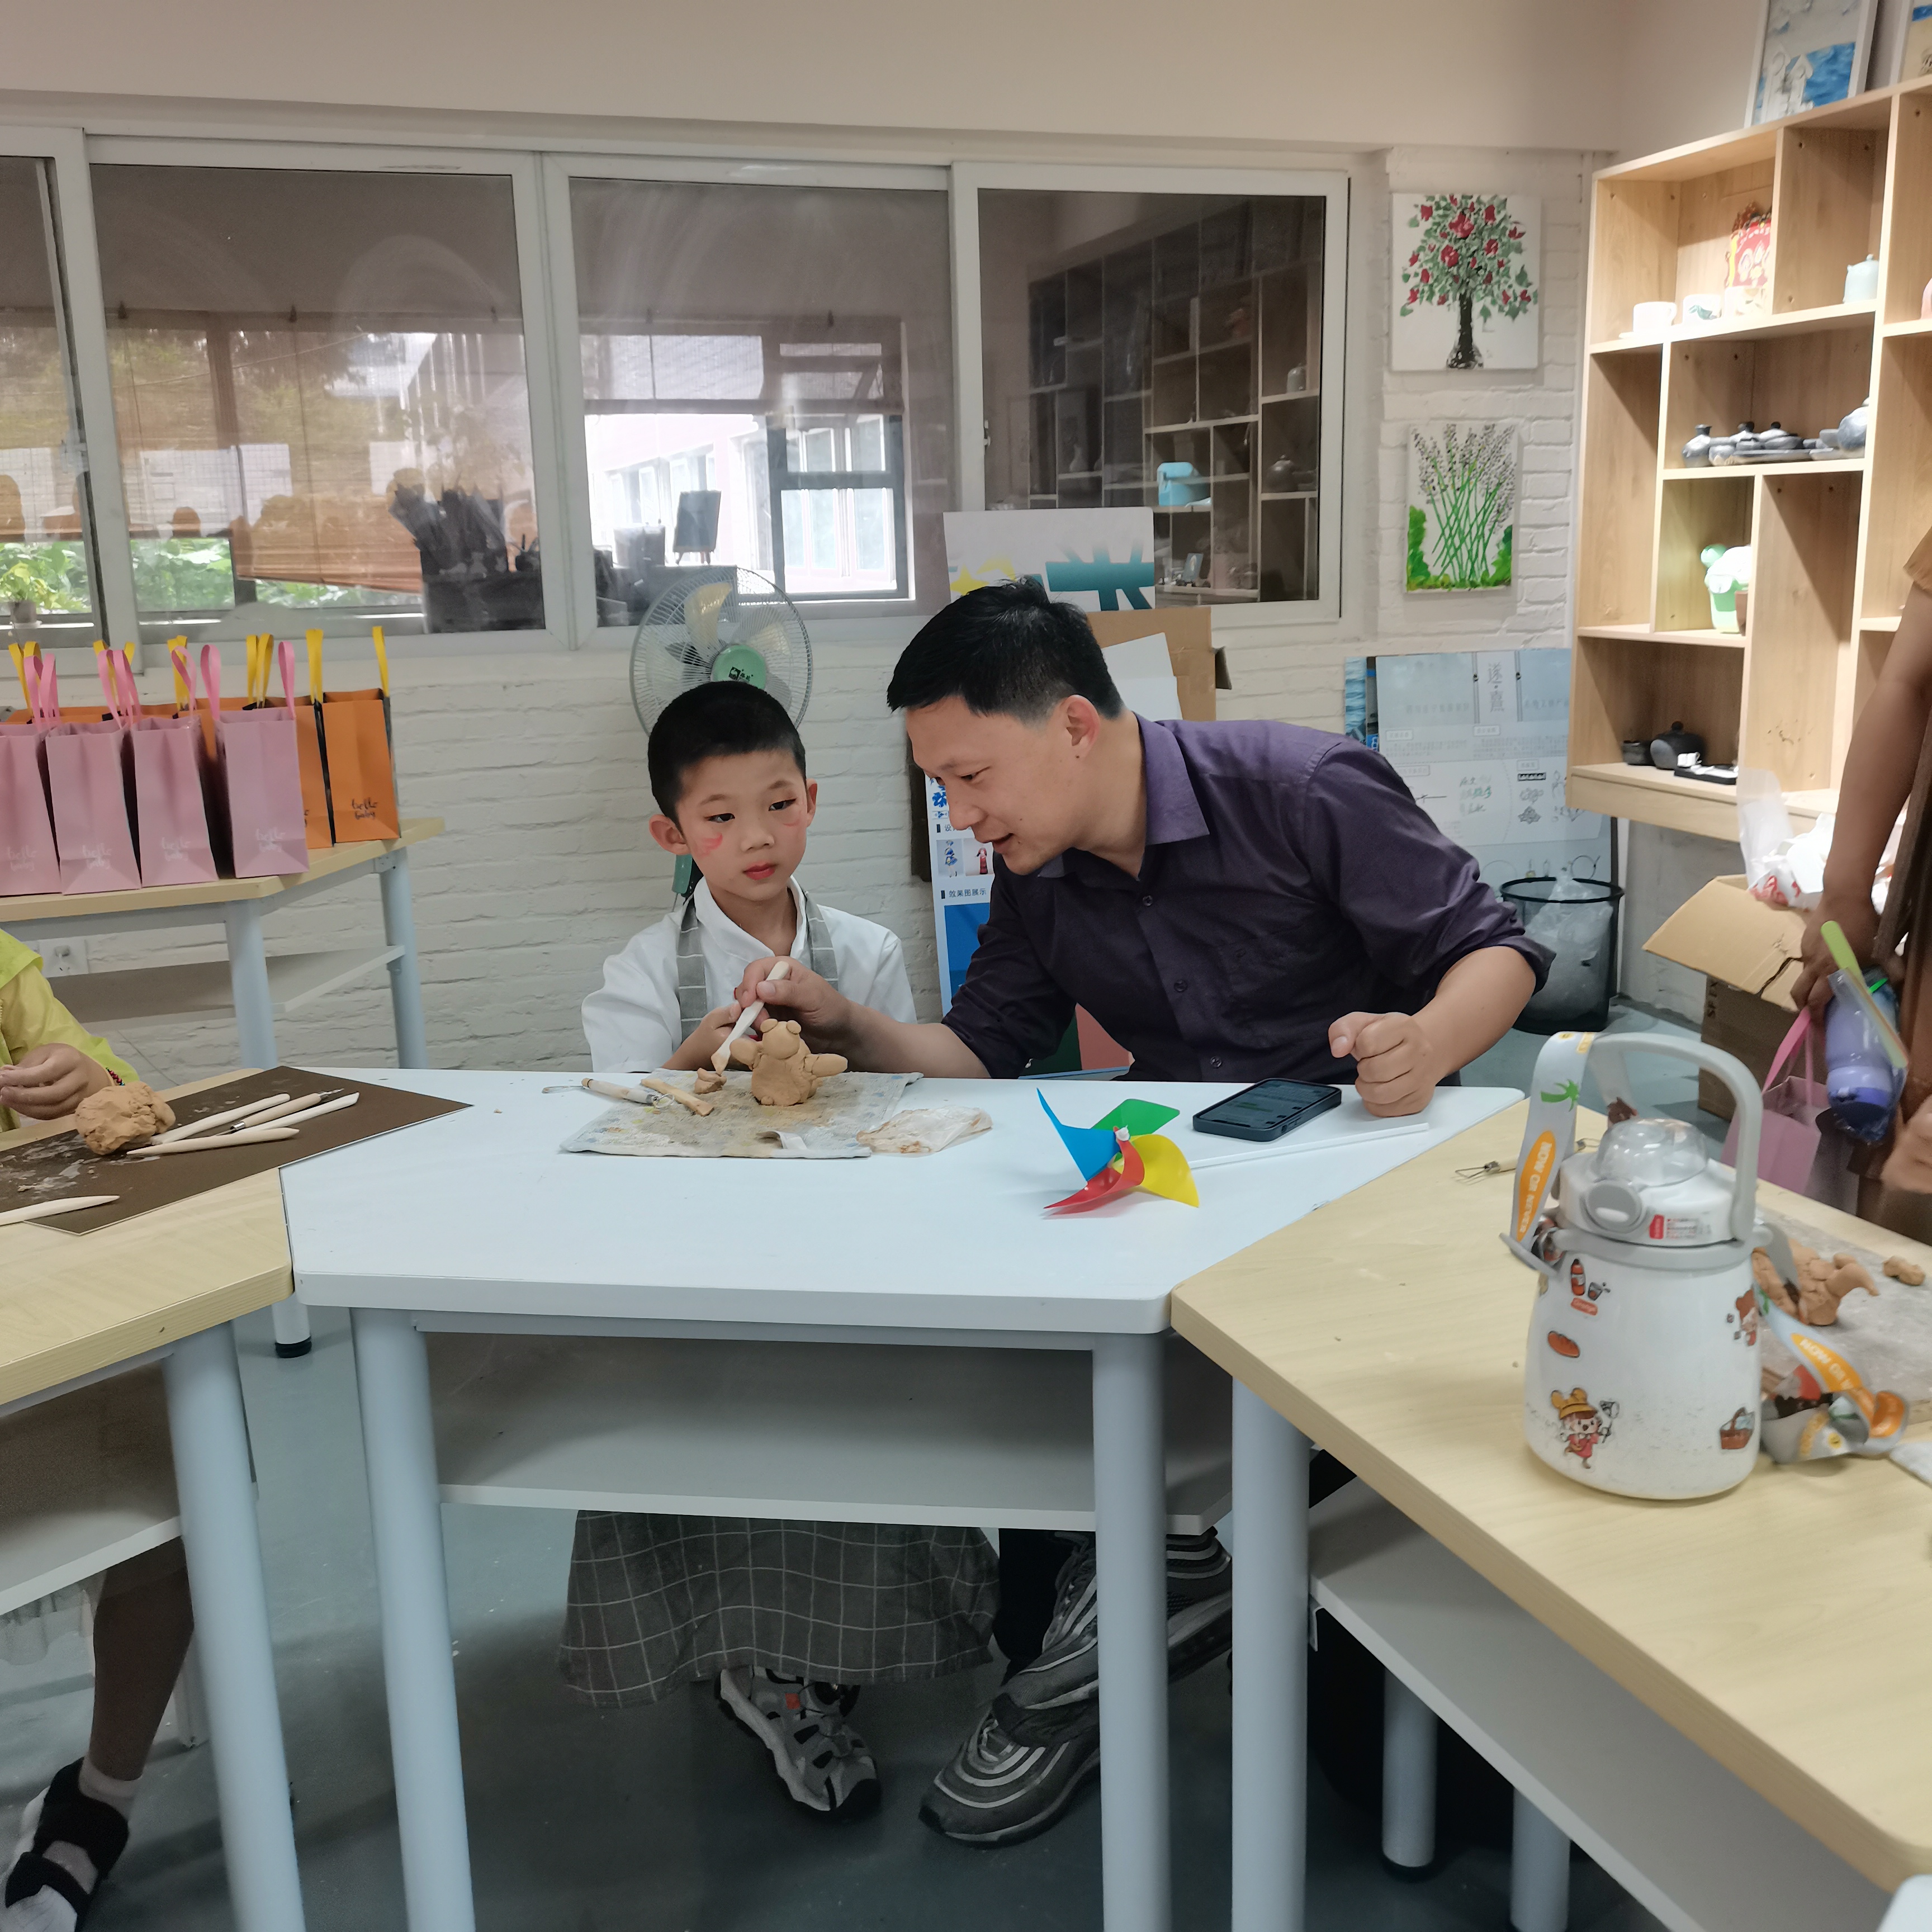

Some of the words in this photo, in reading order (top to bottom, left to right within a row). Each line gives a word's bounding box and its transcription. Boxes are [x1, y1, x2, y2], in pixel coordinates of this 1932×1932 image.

[351, 797, 378, 810] hello
[354, 810, 376, 820] baby
[949, 888, 987, 898] 效果图展示
[1533, 1141, 1553, 1173] NOW
[1529, 1174, 1541, 1192] OR
